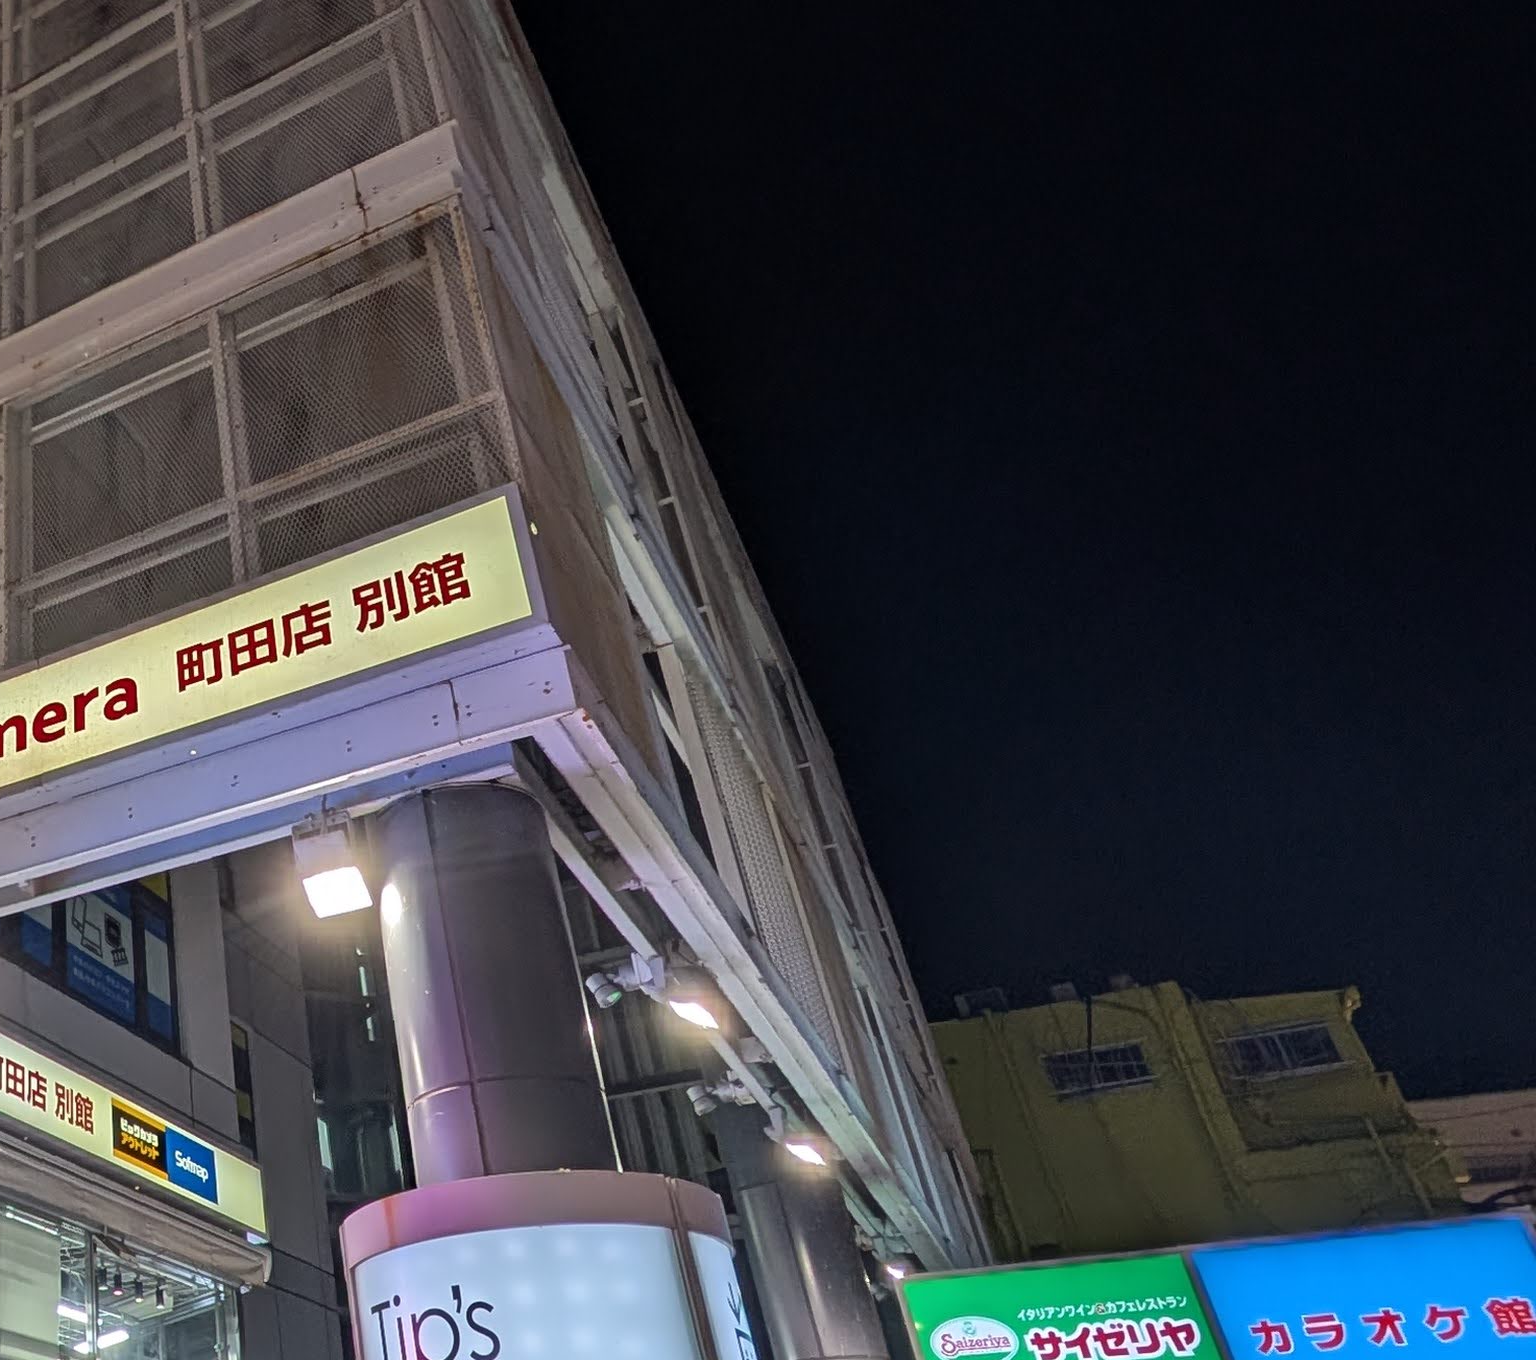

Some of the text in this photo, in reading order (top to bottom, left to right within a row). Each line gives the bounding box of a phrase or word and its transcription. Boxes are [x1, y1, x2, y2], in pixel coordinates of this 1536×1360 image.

[176, 601, 333, 692] 町田店
[353, 553, 471, 635] 別館
[55, 1082, 94, 1134] 別館
[120, 1117, 158, 1147] ビックカメラ
[121, 1132, 159, 1159] アウトレット
[175, 1150, 208, 1183] Sofmap
[1249, 1296, 1536, 1356] カラオケ館
[941, 1333, 1011, 1357] Saizeriya
